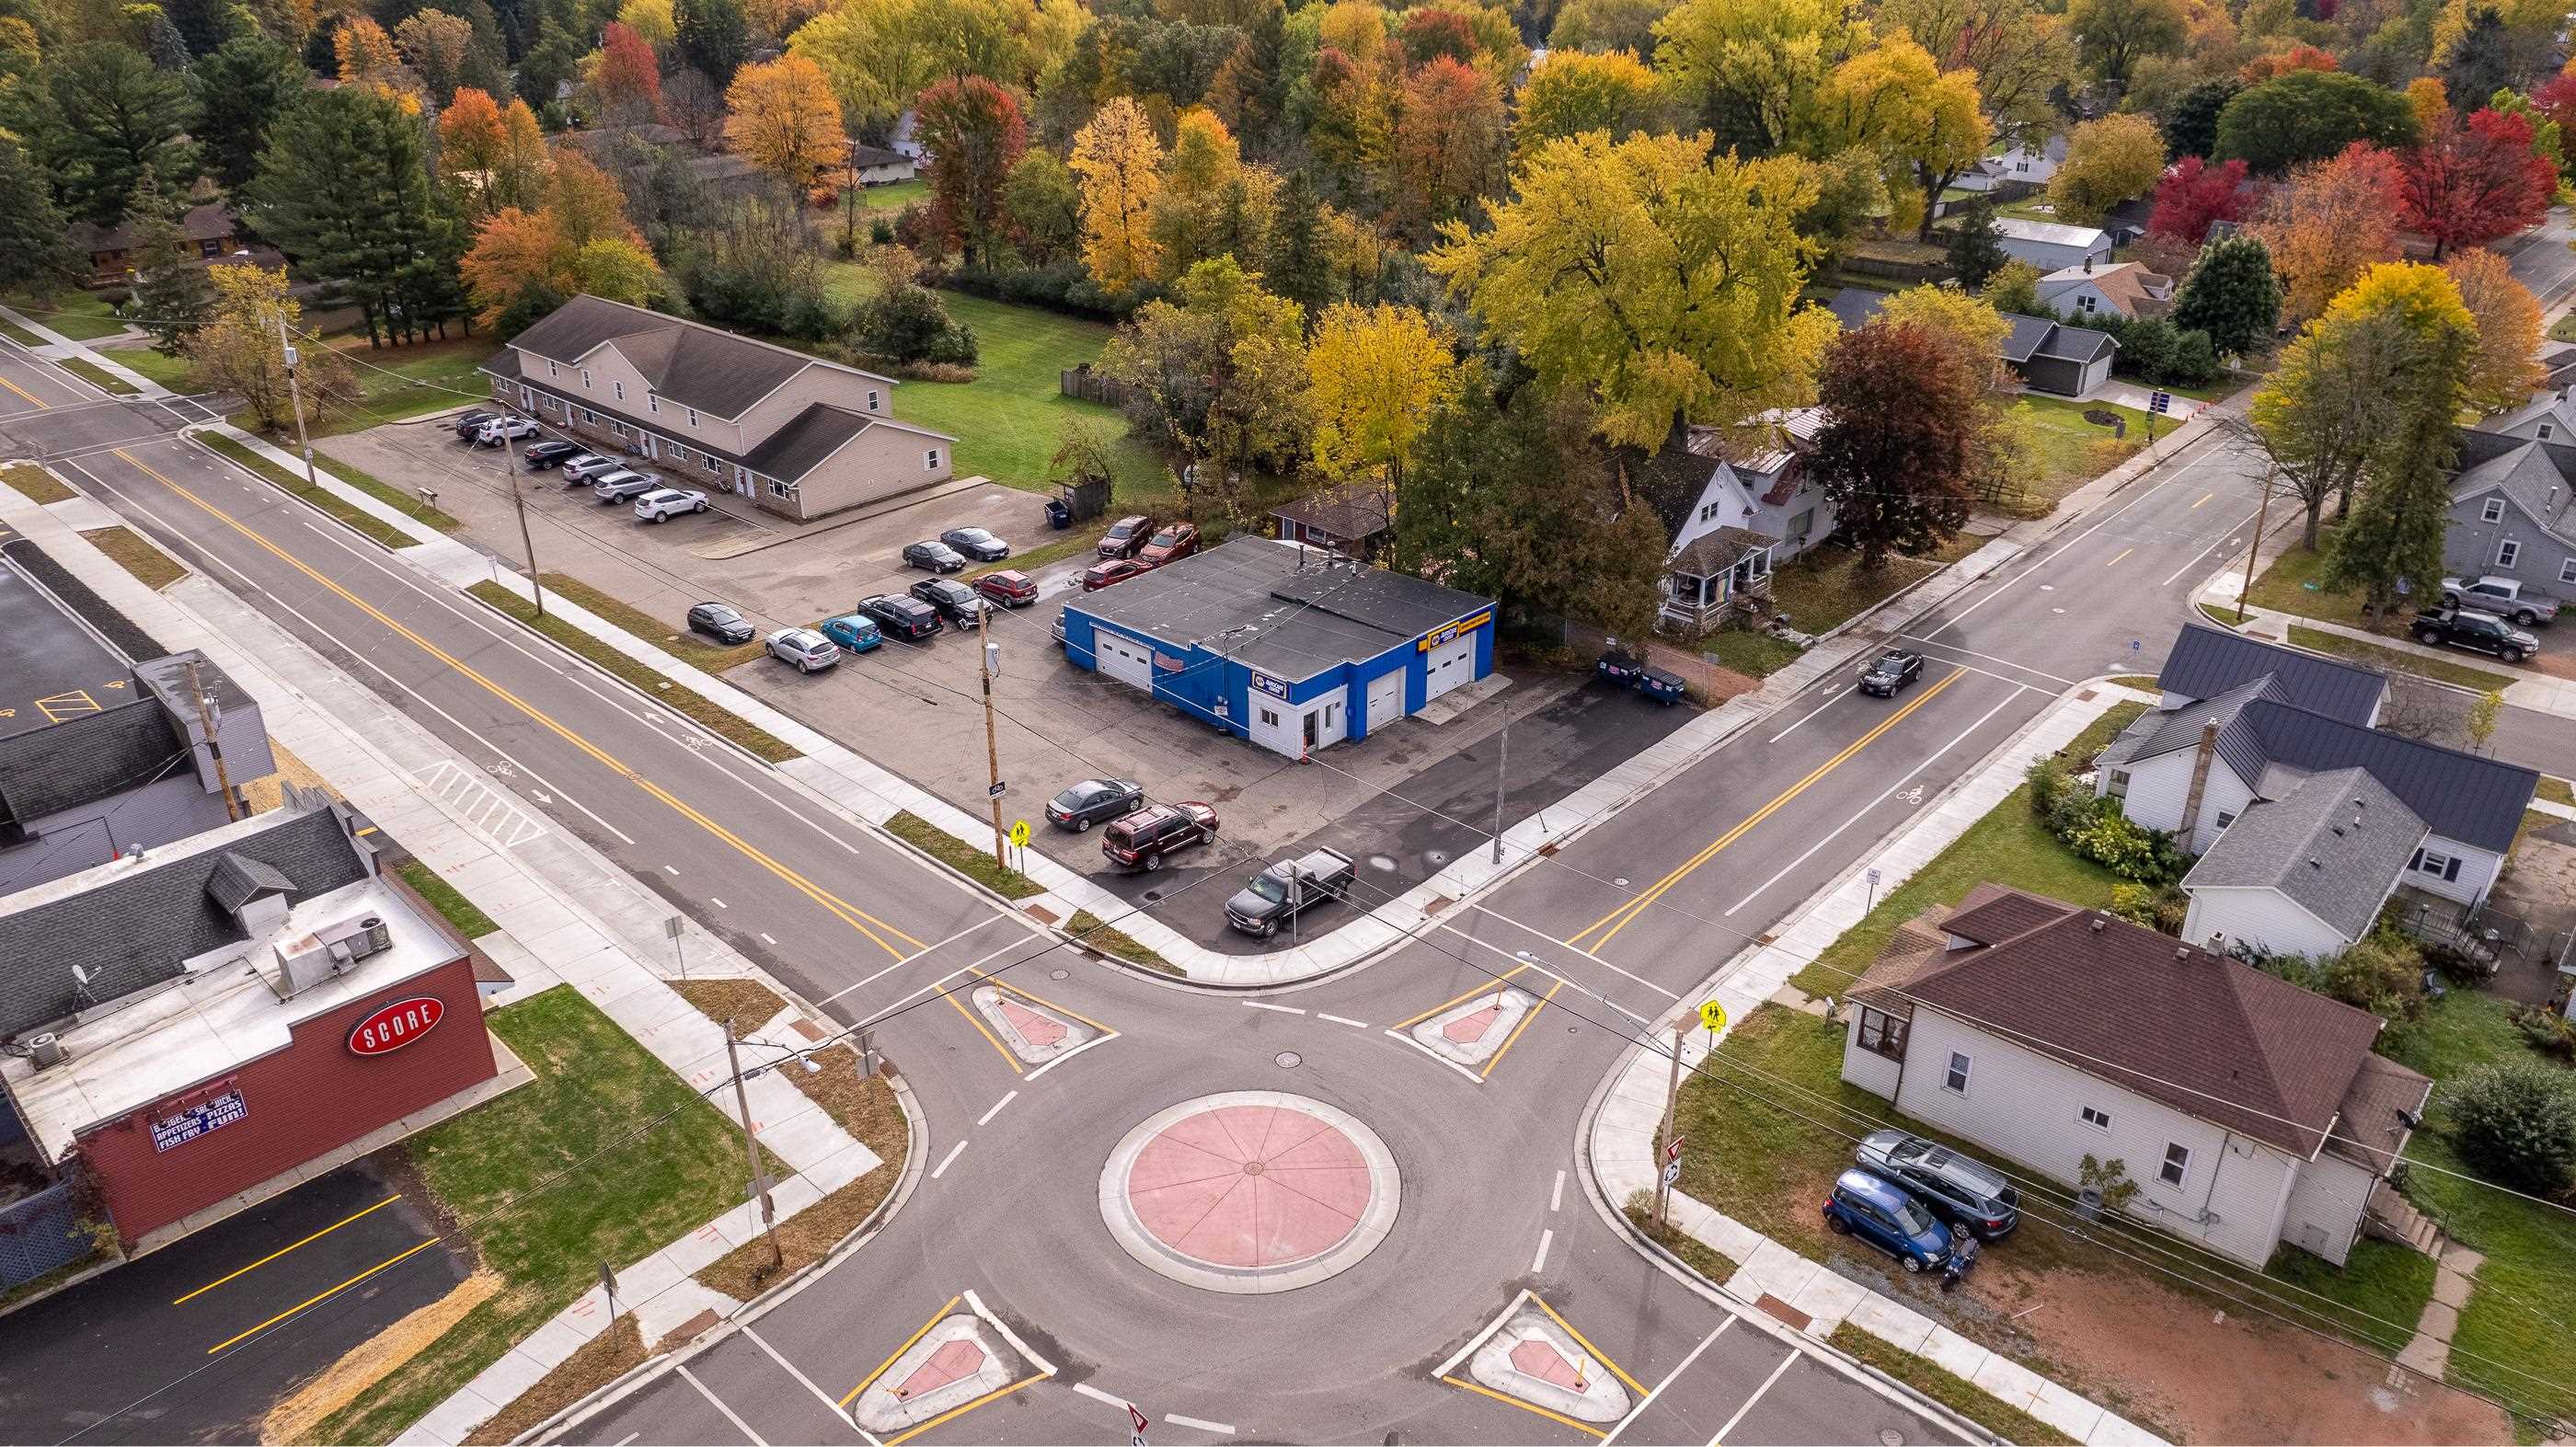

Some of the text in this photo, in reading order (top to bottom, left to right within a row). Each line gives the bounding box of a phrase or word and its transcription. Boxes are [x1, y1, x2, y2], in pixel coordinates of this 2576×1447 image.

[363, 1004, 431, 1049] SCORE
[156, 1100, 241, 1141] APPETIZERS PIZZAS
[159, 1135, 181, 1149] FISH
[182, 1126, 201, 1140] FRY
